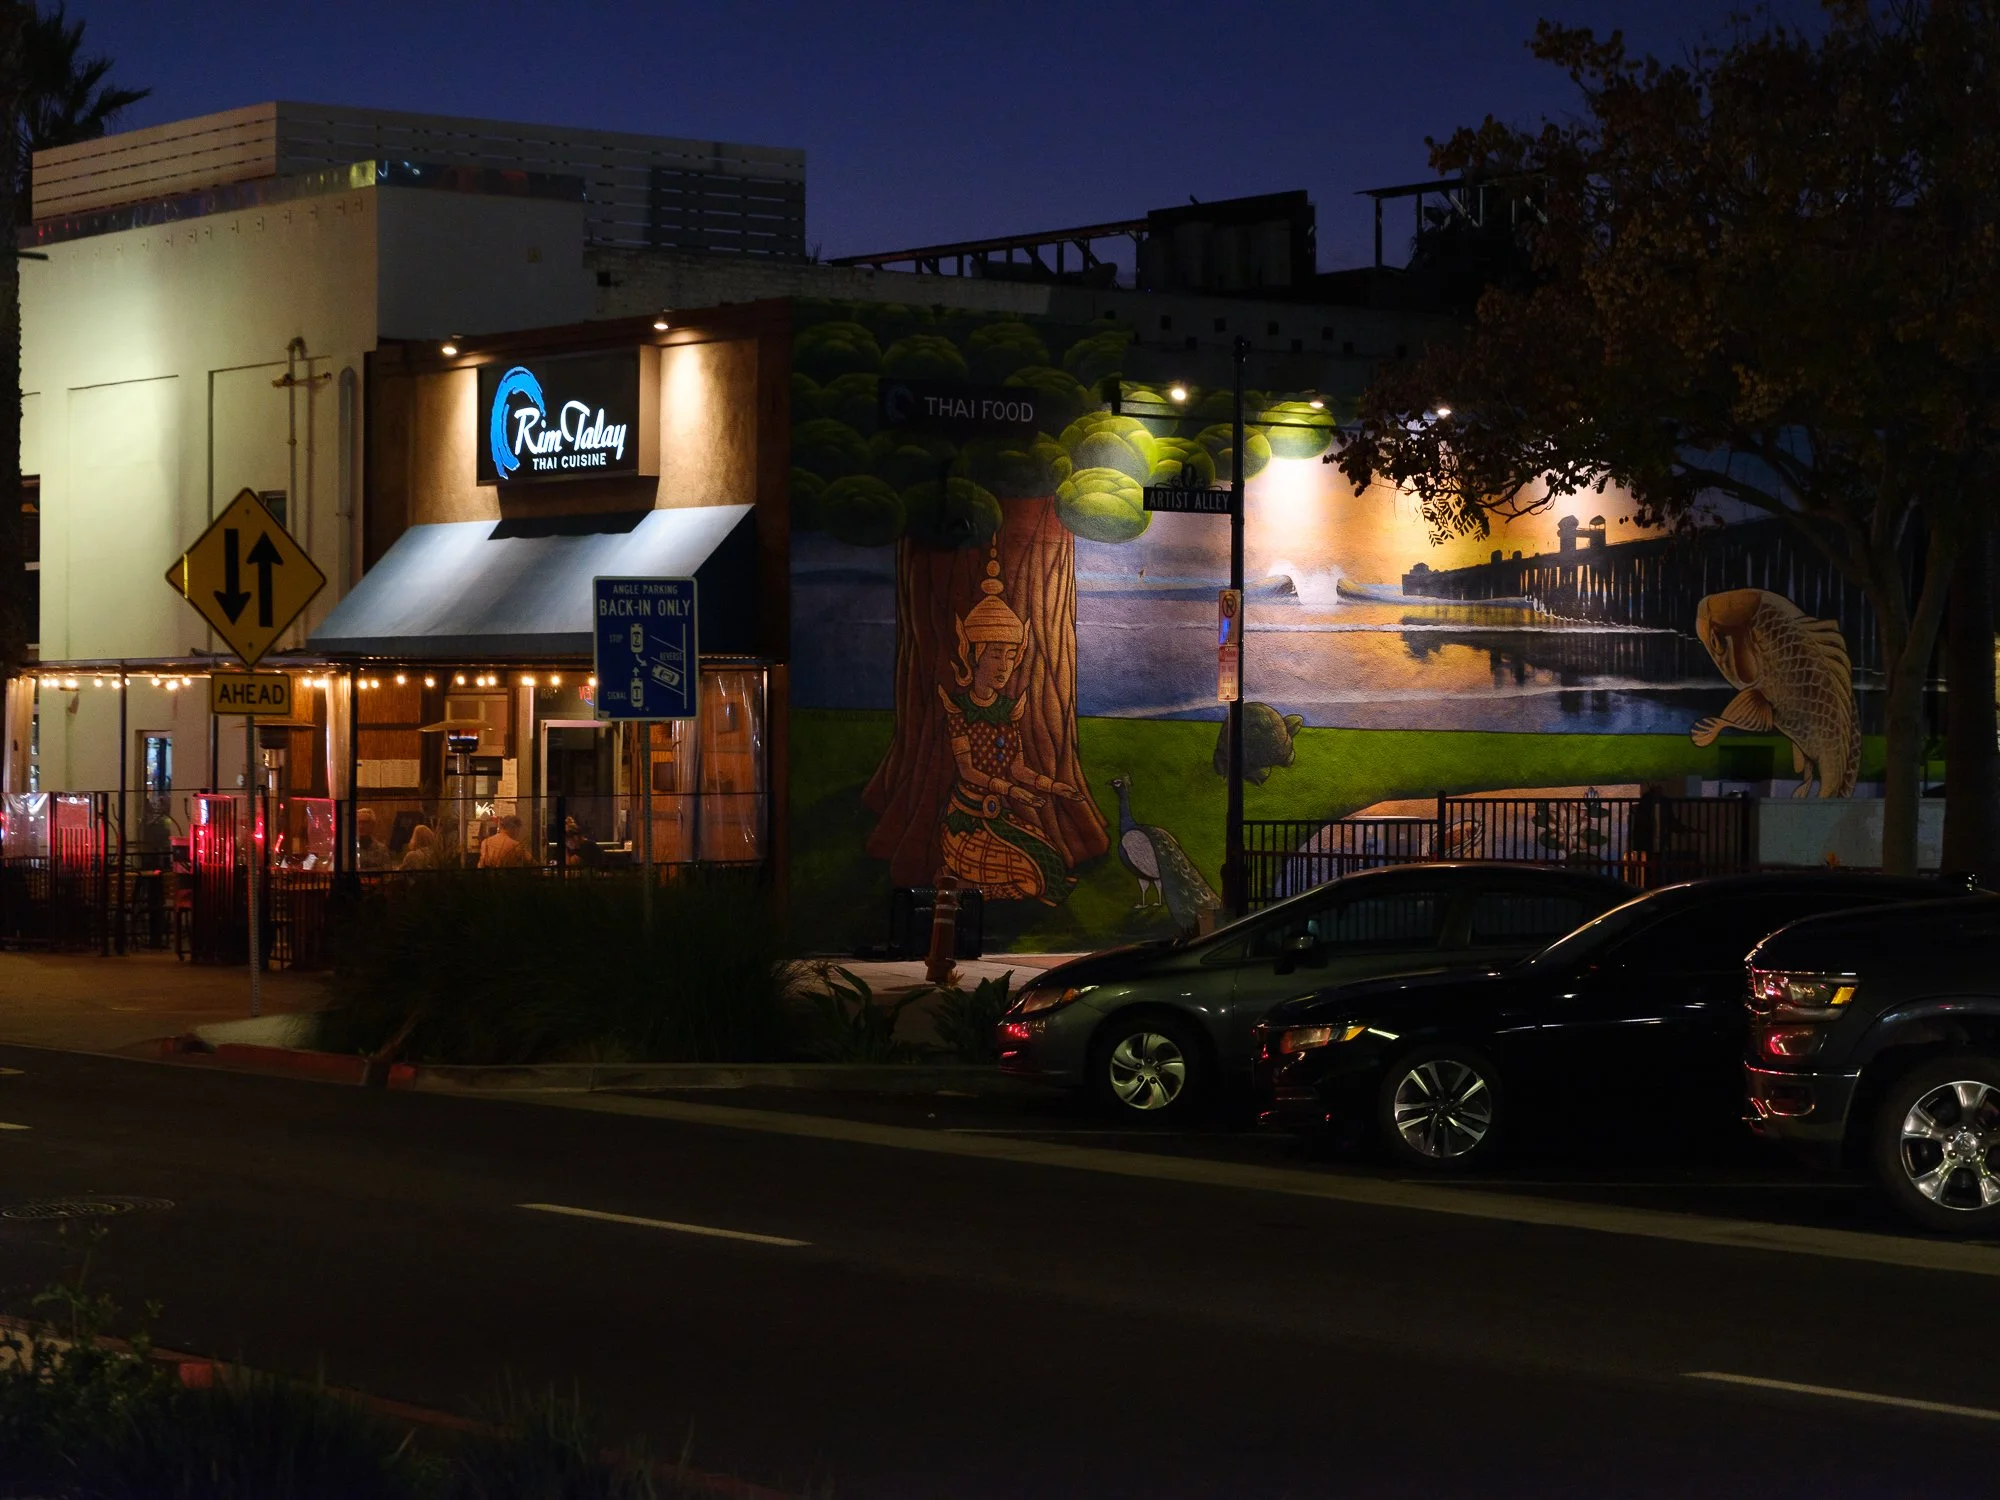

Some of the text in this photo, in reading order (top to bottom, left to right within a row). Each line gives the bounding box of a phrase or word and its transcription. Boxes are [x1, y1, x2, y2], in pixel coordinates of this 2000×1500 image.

[924, 396, 1034, 423] THAI FOOD
[513, 400, 627, 461] Rim Talay
[532, 452, 607, 471] THAI CUISINE
[1149, 489, 1231, 511] ARTIST ALLEY
[612, 584, 679, 595] ANGLE PARKING
[599, 599, 692, 617] BACK-IN ONLY
[219, 683, 285, 704] AHEAD
